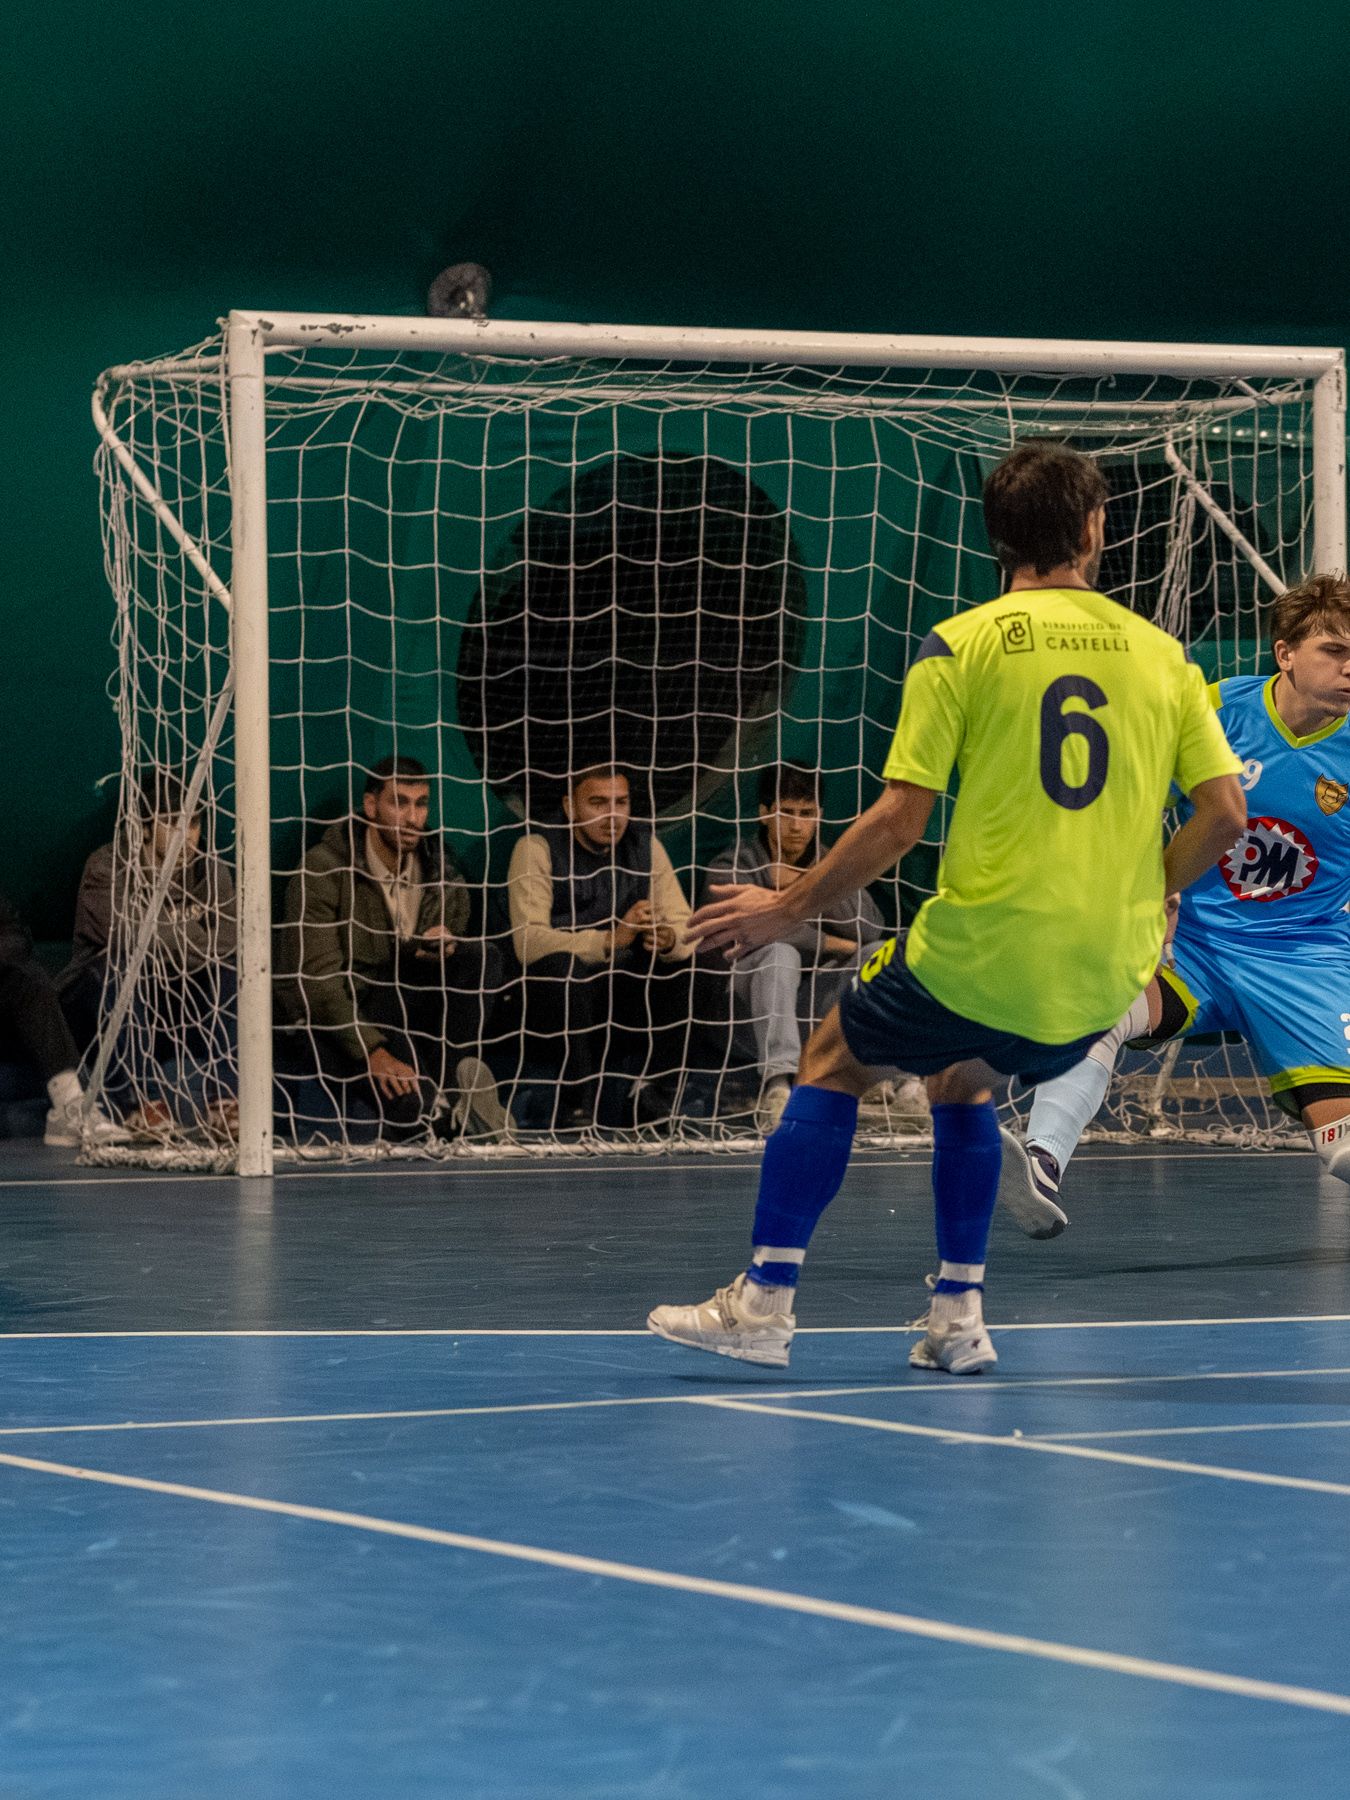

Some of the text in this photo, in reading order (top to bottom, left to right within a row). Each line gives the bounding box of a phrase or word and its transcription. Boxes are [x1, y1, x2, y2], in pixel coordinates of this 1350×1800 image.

[1046, 636, 1129, 652] CASTELLI
[1040, 674, 1110, 811] 6
[1234, 754, 1263, 791] 9
[1239, 835, 1300, 890] PM
